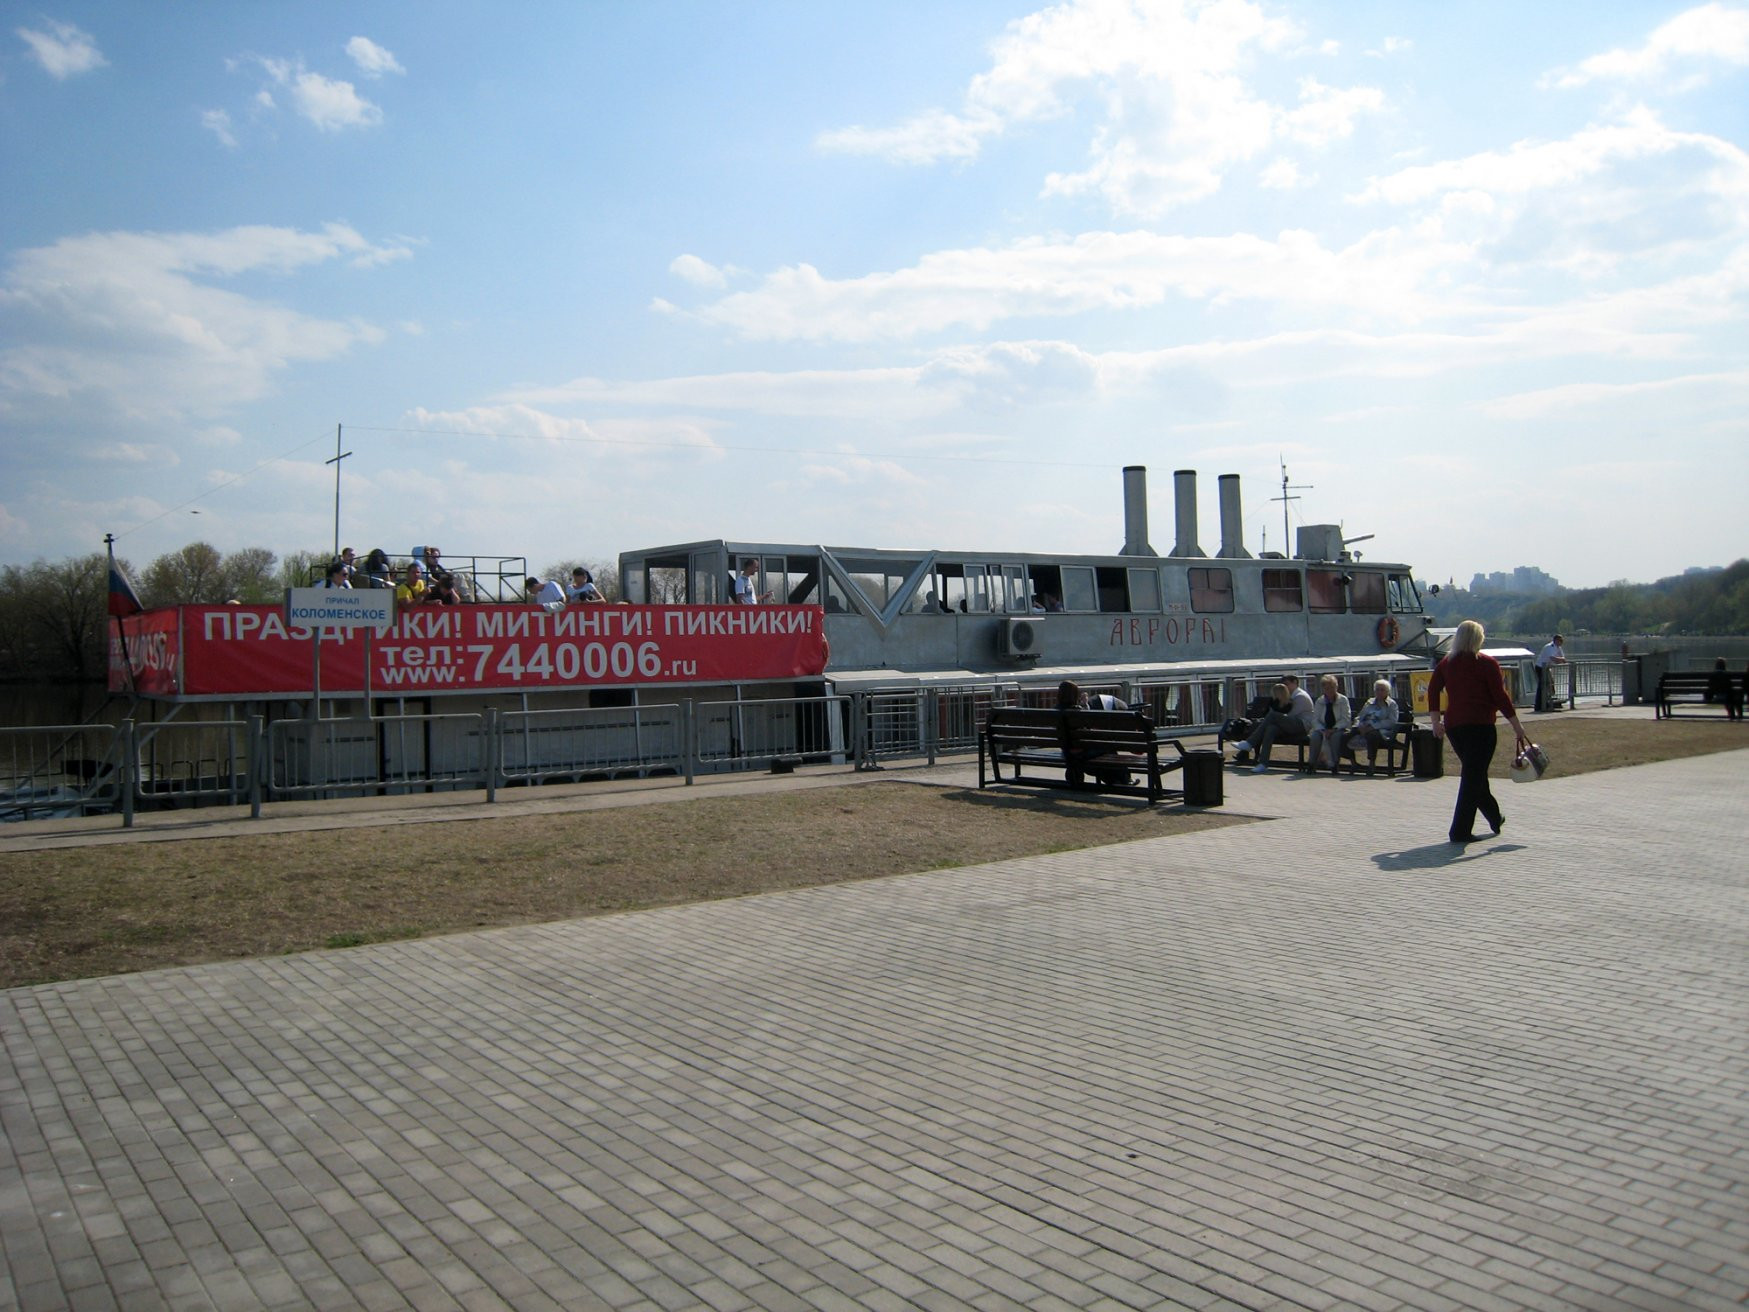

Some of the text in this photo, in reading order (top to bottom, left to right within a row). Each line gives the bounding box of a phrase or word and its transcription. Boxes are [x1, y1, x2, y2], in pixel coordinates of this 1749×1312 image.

[325, 597, 360, 605] ПРИЧАЛ
[292, 608, 386, 620] КОЛОМЕНСКОЕ
[204, 610, 814, 645] ПРАЗДИКИ! МИТИНГИ! ПИКНИКИ!
